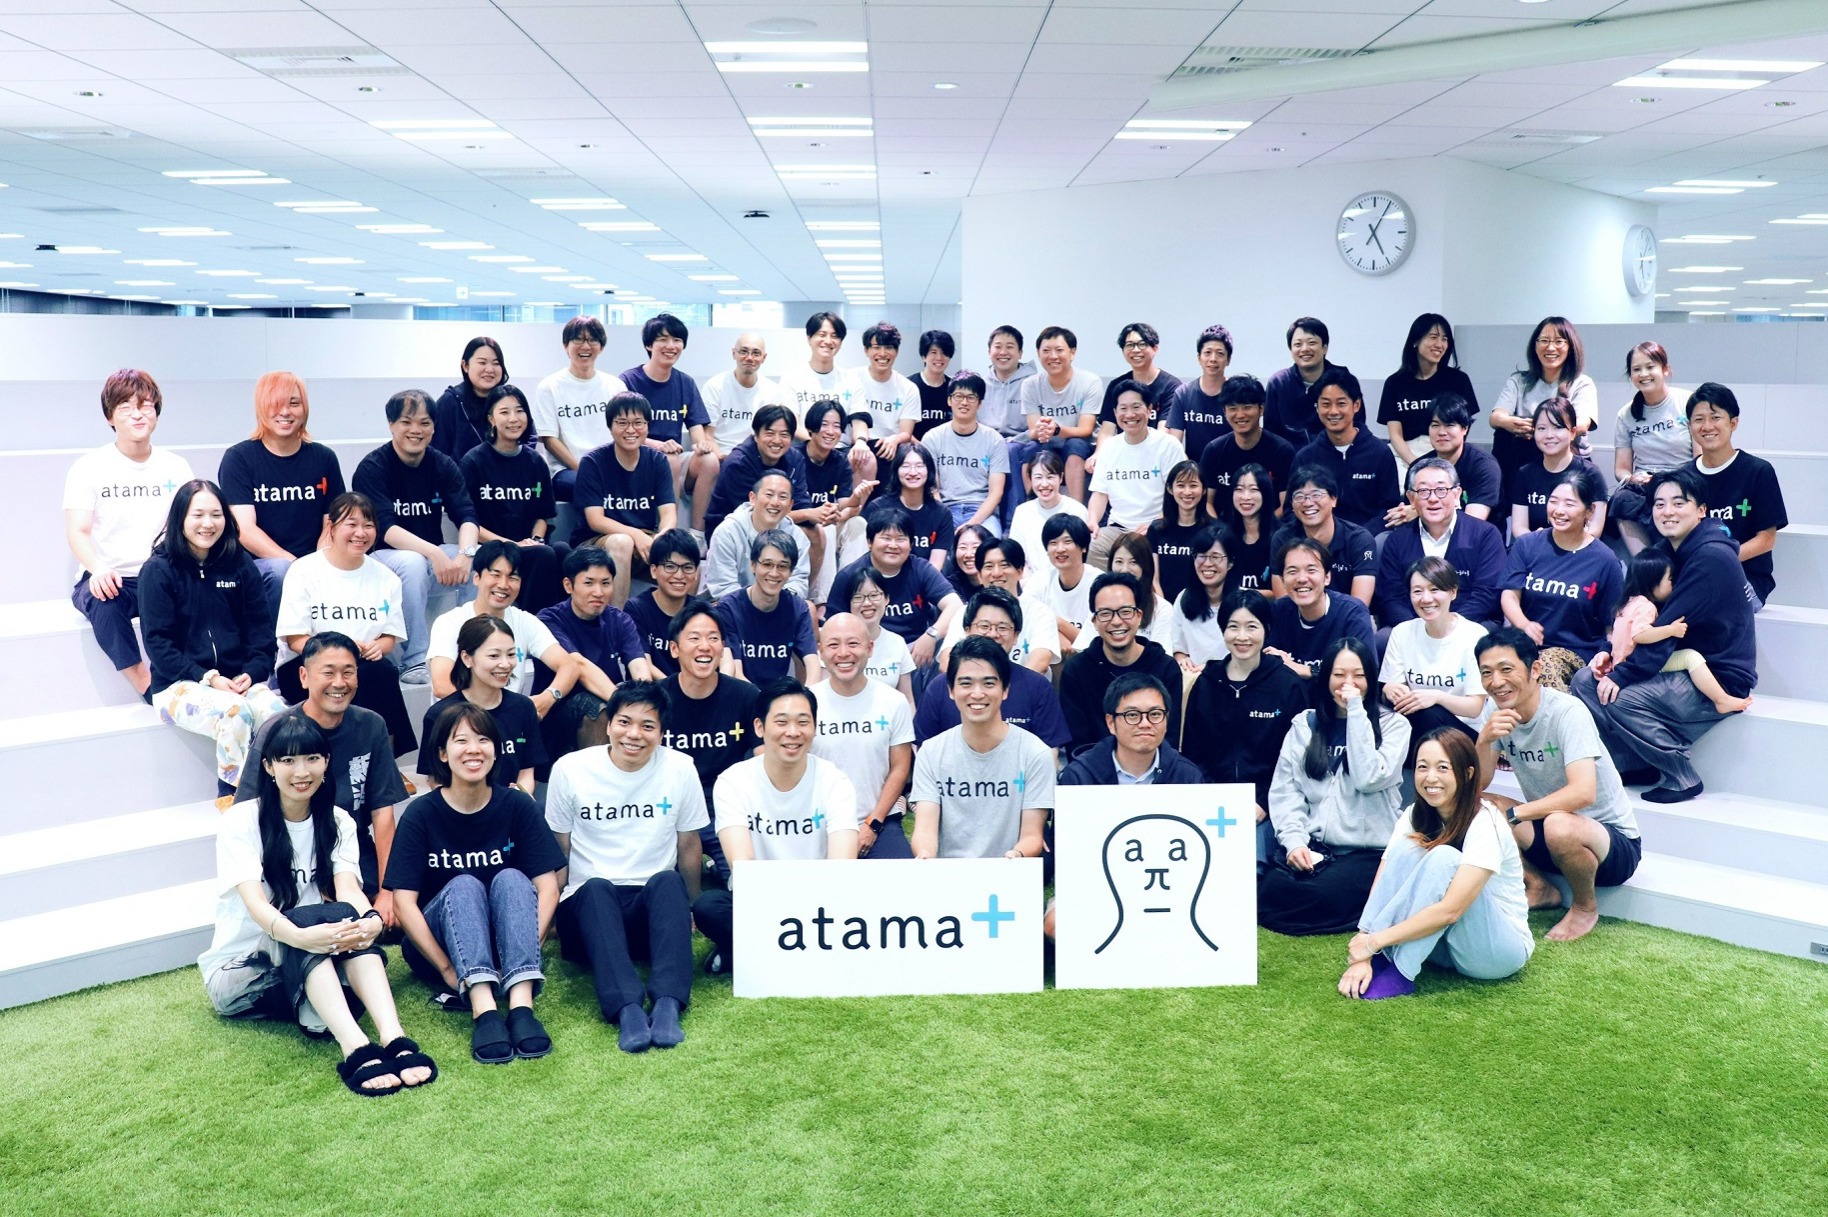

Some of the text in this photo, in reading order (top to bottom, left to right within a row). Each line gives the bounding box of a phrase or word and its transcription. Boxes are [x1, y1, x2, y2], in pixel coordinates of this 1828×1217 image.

[557, 401, 607, 418] atama
[651, 404, 688, 422] ma+
[865, 397, 902, 412] ma+
[1037, 398, 1084, 417] tama+
[1396, 398, 1431, 412] atam
[721, 408, 752, 421] atam
[1184, 409, 1223, 425] atama
[1630, 415, 1688, 437] tama+
[937, 452, 990, 469] tama+
[1107, 466, 1160, 481] atama+
[1352, 472, 1376, 480] atama+
[101, 479, 177, 498] atama+
[253, 476, 328, 502] atama+
[480, 482, 542, 501] atama+
[603, 494, 655, 510] tama
[1709, 498, 1752, 521] ma+
[1157, 544, 1191, 556] atam
[216, 580, 237, 588] atam
[1525, 573, 1597, 600] tama+
[311, 599, 389, 622] atama+
[884, 594, 924, 617] ma+
[742, 640, 794, 659] tama
[866, 662, 898, 676] ma+
[1407, 667, 1466, 688] tama+
[1249, 708, 1281, 719] atama+
[815, 715, 889, 736] tama+
[662, 722, 745, 750] tama+
[1507, 740, 1558, 764] tma+
[938, 770, 1025, 798] atama+
[580, 796, 672, 821] atama+
[428, 838, 515, 869] atama+
[778, 893, 1016, 951] atama+
